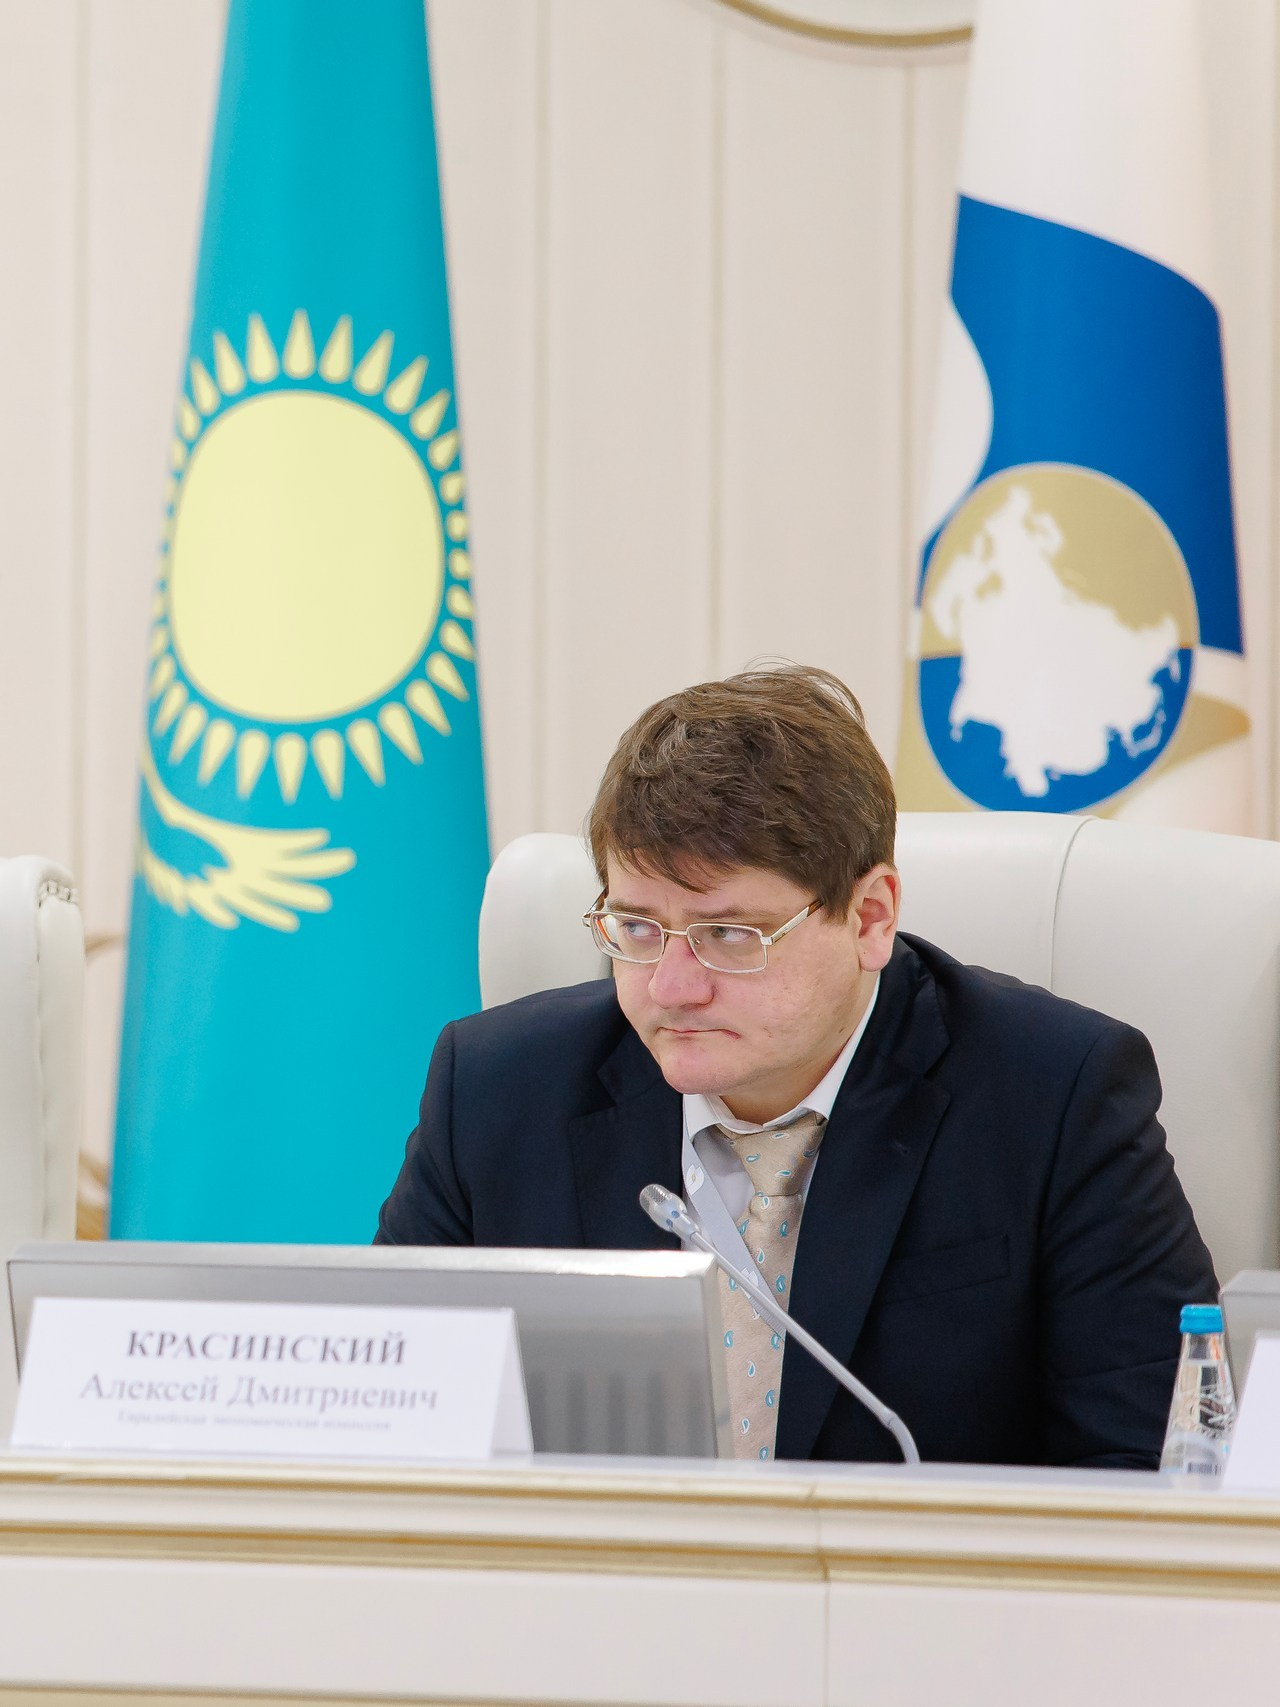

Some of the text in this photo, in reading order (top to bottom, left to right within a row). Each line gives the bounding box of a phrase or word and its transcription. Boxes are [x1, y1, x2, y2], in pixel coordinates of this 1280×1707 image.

[125, 1330, 408, 1366] КРАСИНСКИЙ
[79, 1373, 440, 1414] Алексей Дмитриевич
